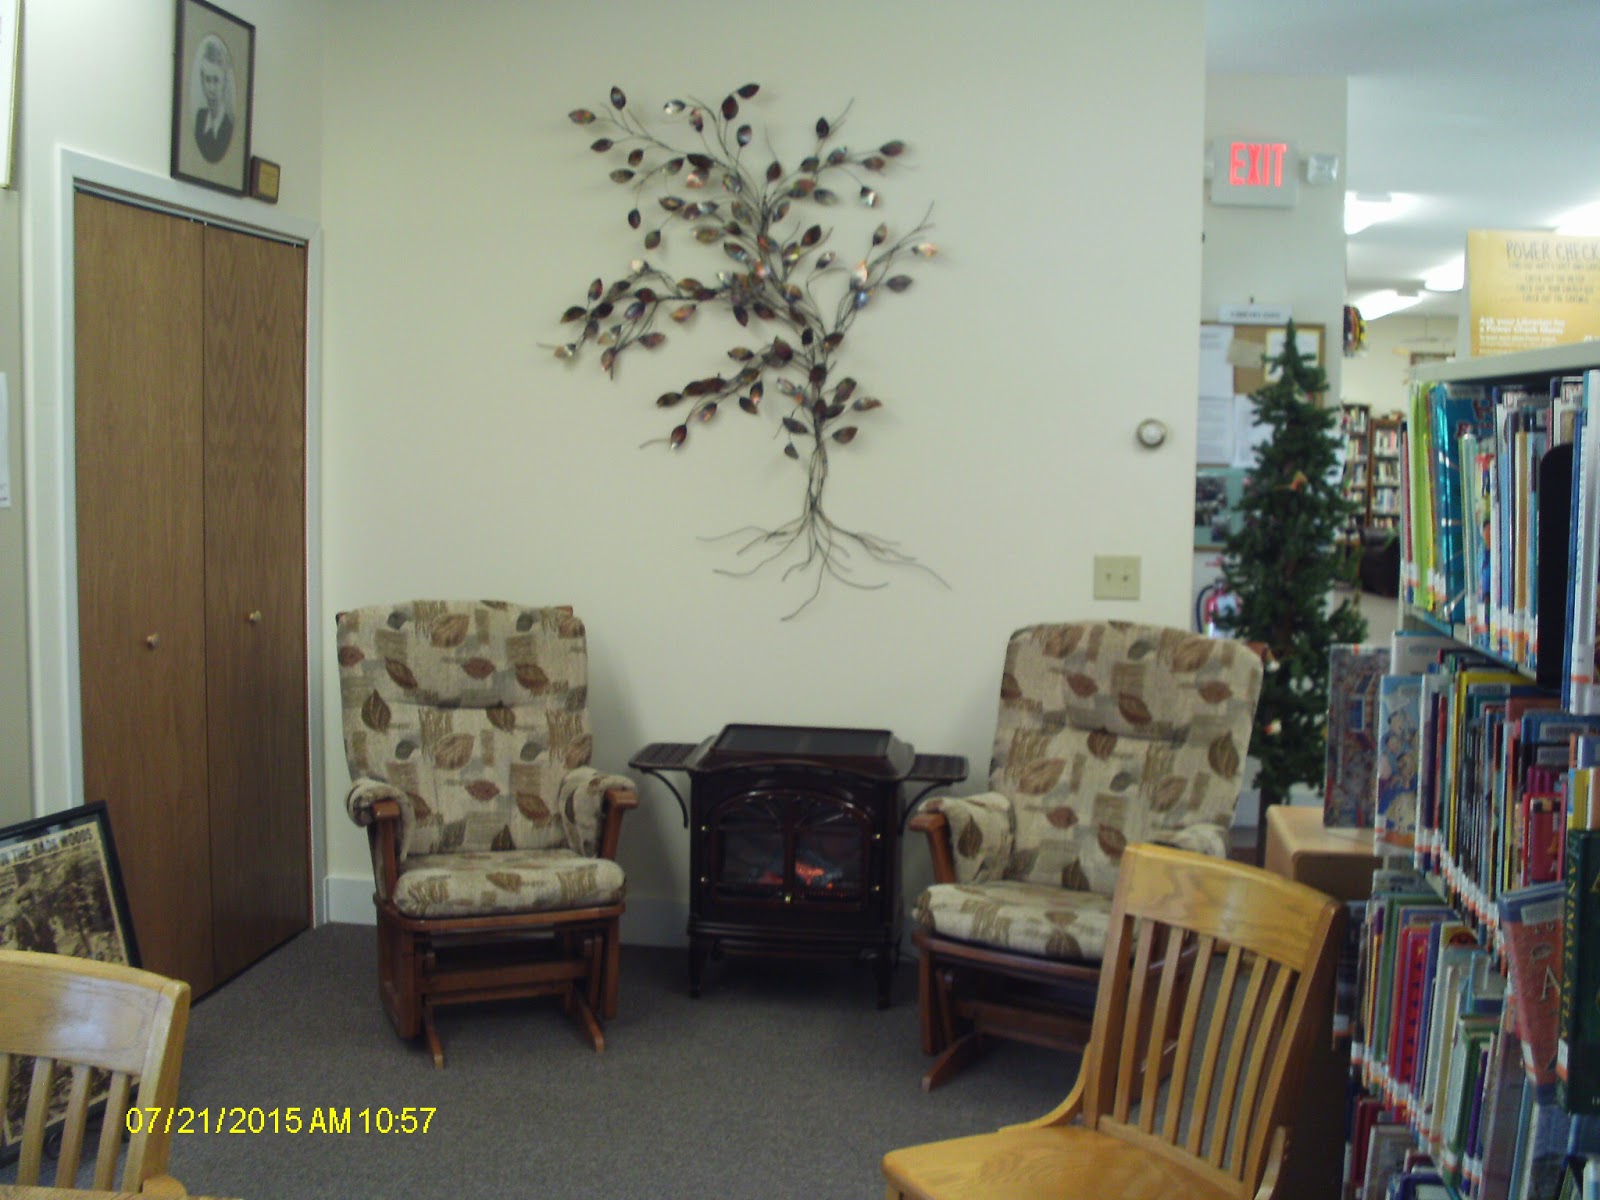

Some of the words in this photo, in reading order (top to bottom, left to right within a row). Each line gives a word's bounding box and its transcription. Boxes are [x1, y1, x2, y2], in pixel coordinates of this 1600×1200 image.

[1229, 142, 1288, 187] EXIT
[1506, 240, 1550, 260] POWER
[1556, 240, 1600, 262] CHECK
